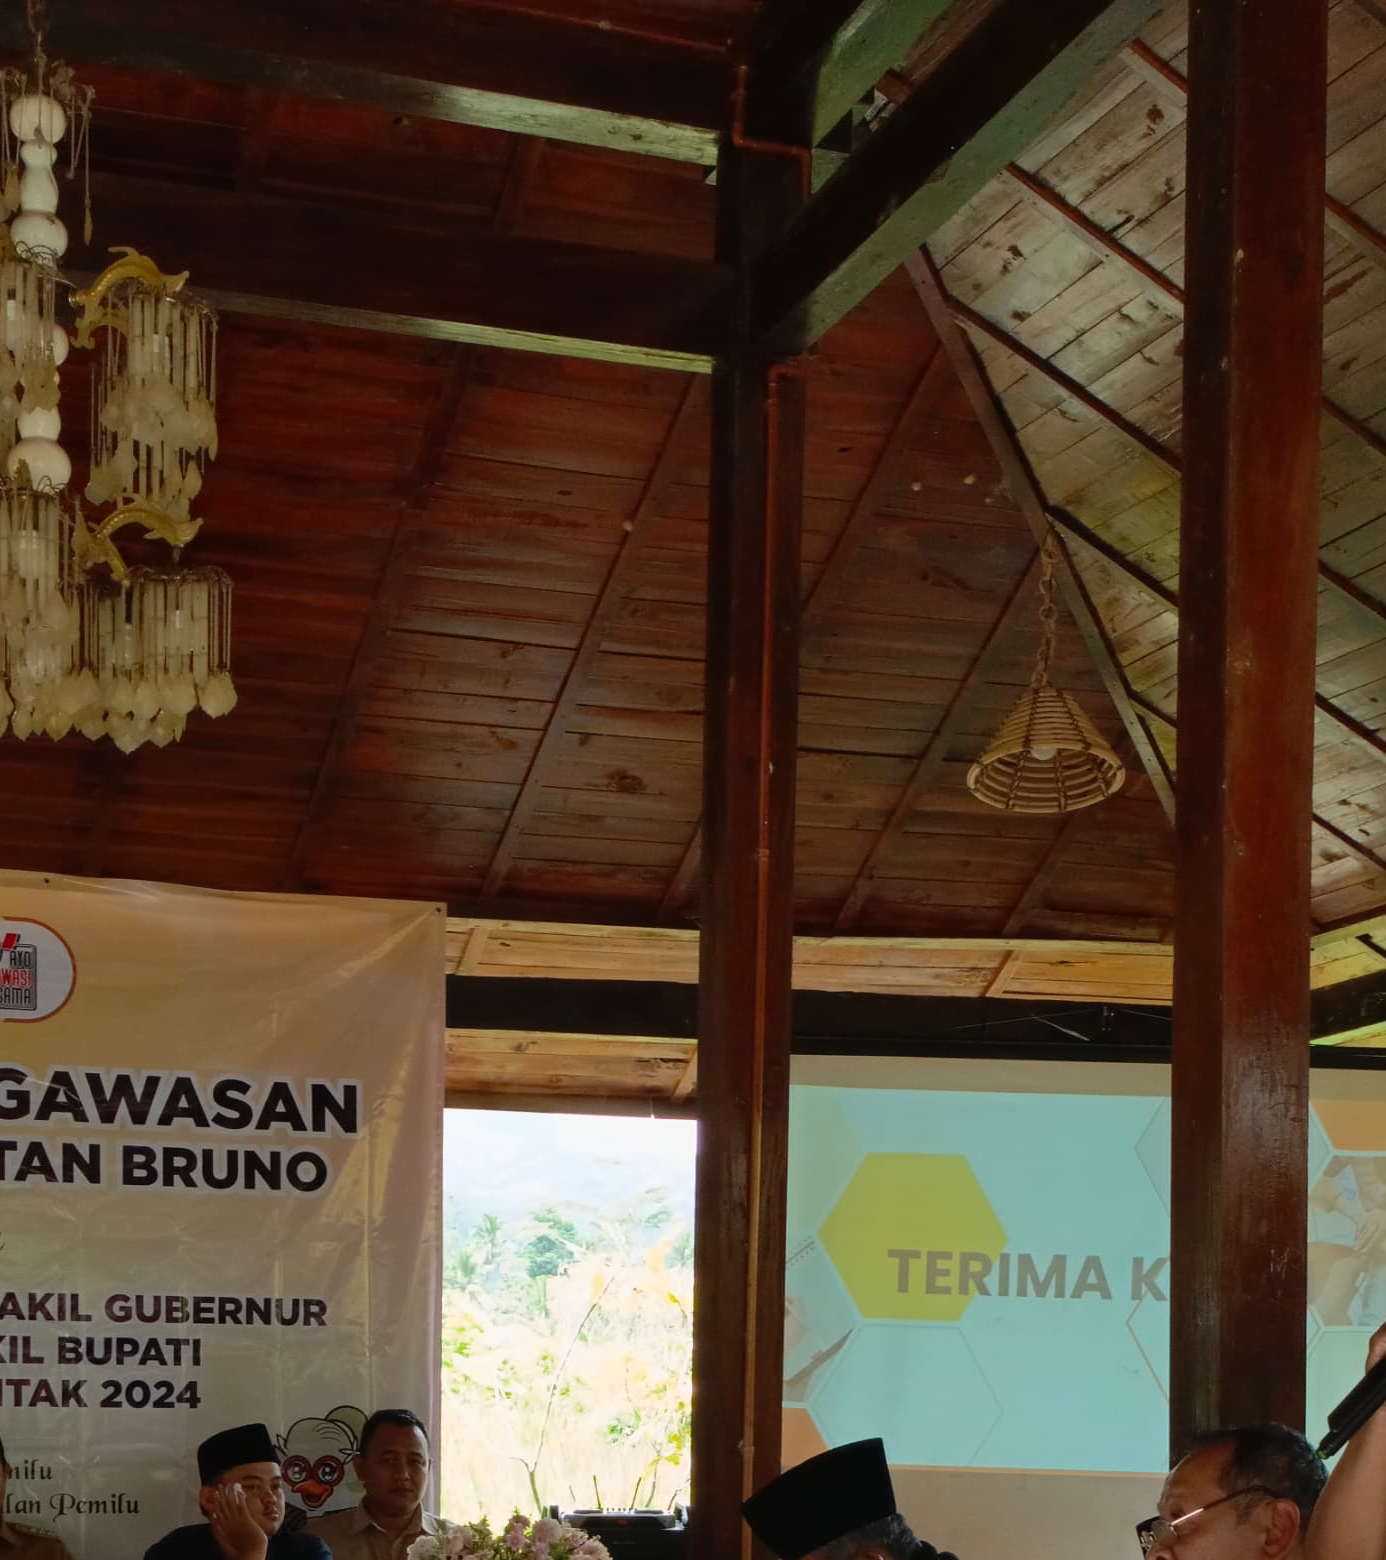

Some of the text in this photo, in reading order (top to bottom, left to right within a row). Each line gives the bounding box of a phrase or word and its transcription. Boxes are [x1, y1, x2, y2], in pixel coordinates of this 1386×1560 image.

[9, 950, 31, 968] AYO
[122, 1145, 328, 1192] BRUNO
[887, 1248, 1113, 1301] TERIMA
[104, 1294, 328, 1327] GUBERNUR
[57, 1336, 202, 1367] BUPATI
[99, 1380, 202, 1410] 2024
[49, 1493, 140, 1523] Pemilu
